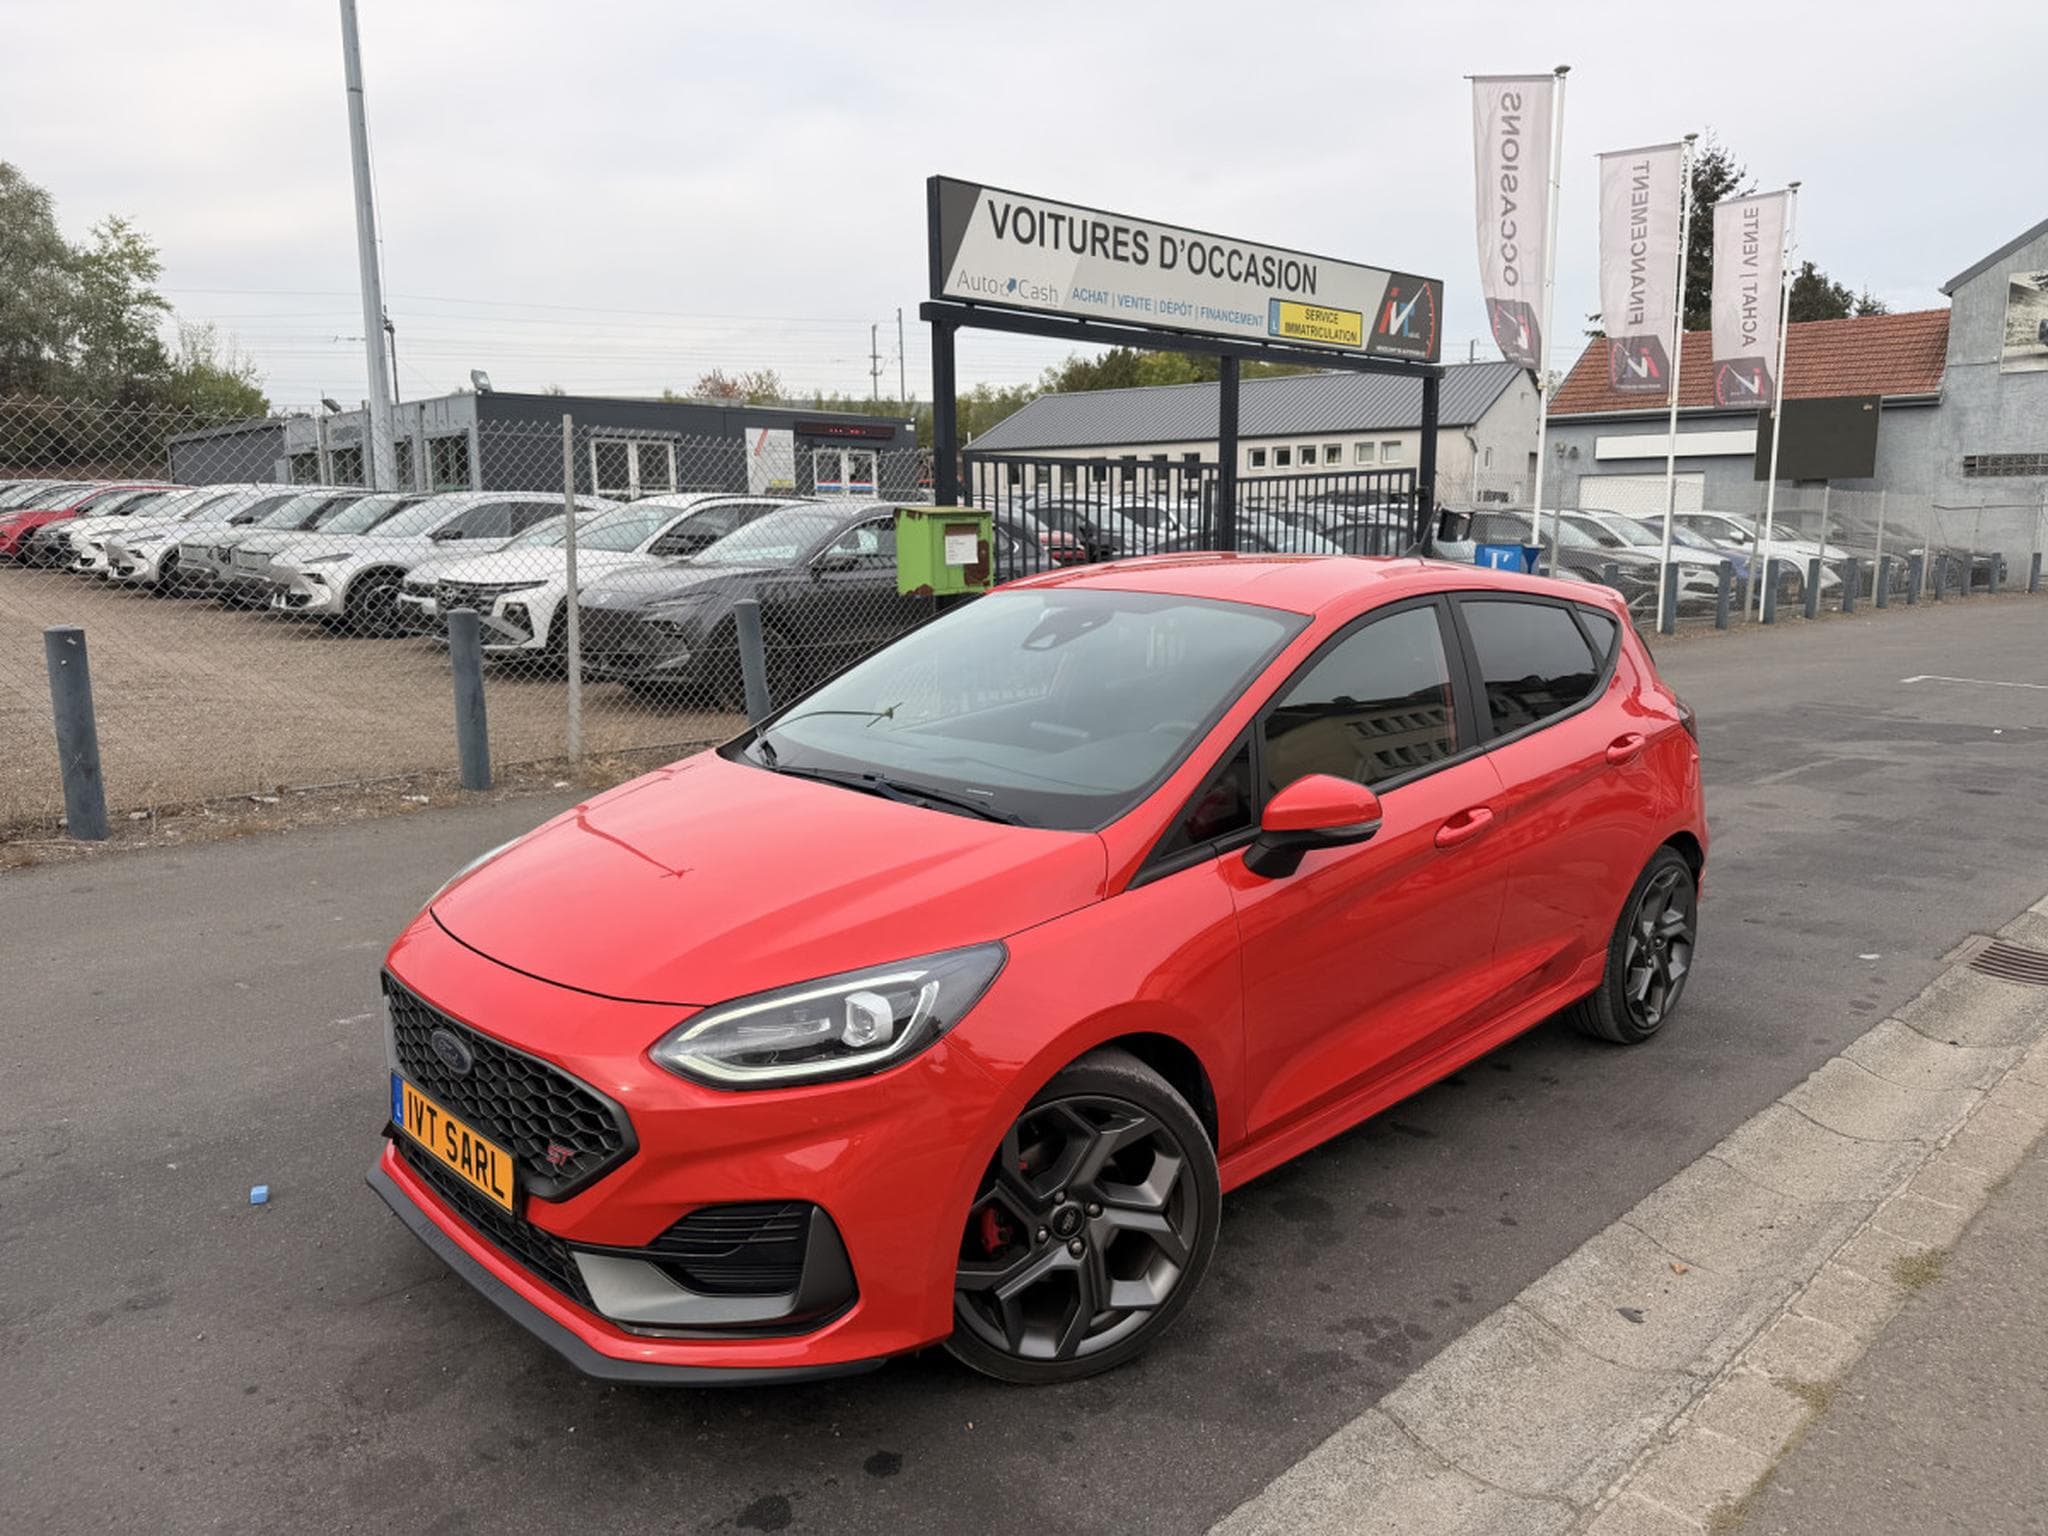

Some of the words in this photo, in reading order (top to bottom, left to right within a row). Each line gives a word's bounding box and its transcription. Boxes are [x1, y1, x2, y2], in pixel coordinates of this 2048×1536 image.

[988, 199, 1150, 266] VOITURES
[1159, 234, 1318, 296] D'OCCASION
[1018, 279, 1059, 305] Cash
[1072, 287, 1109, 305] ACHAT
[1117, 294, 1152, 311] VENTE
[1200, 306, 1264, 328] FINANCEMENT
[1284, 321, 1358, 343] IMMATRICULATION
[1304, 308, 1340, 325] SERVICE
[408, 1091, 438, 1148] IVT
[445, 1120, 505, 1200] SARL
